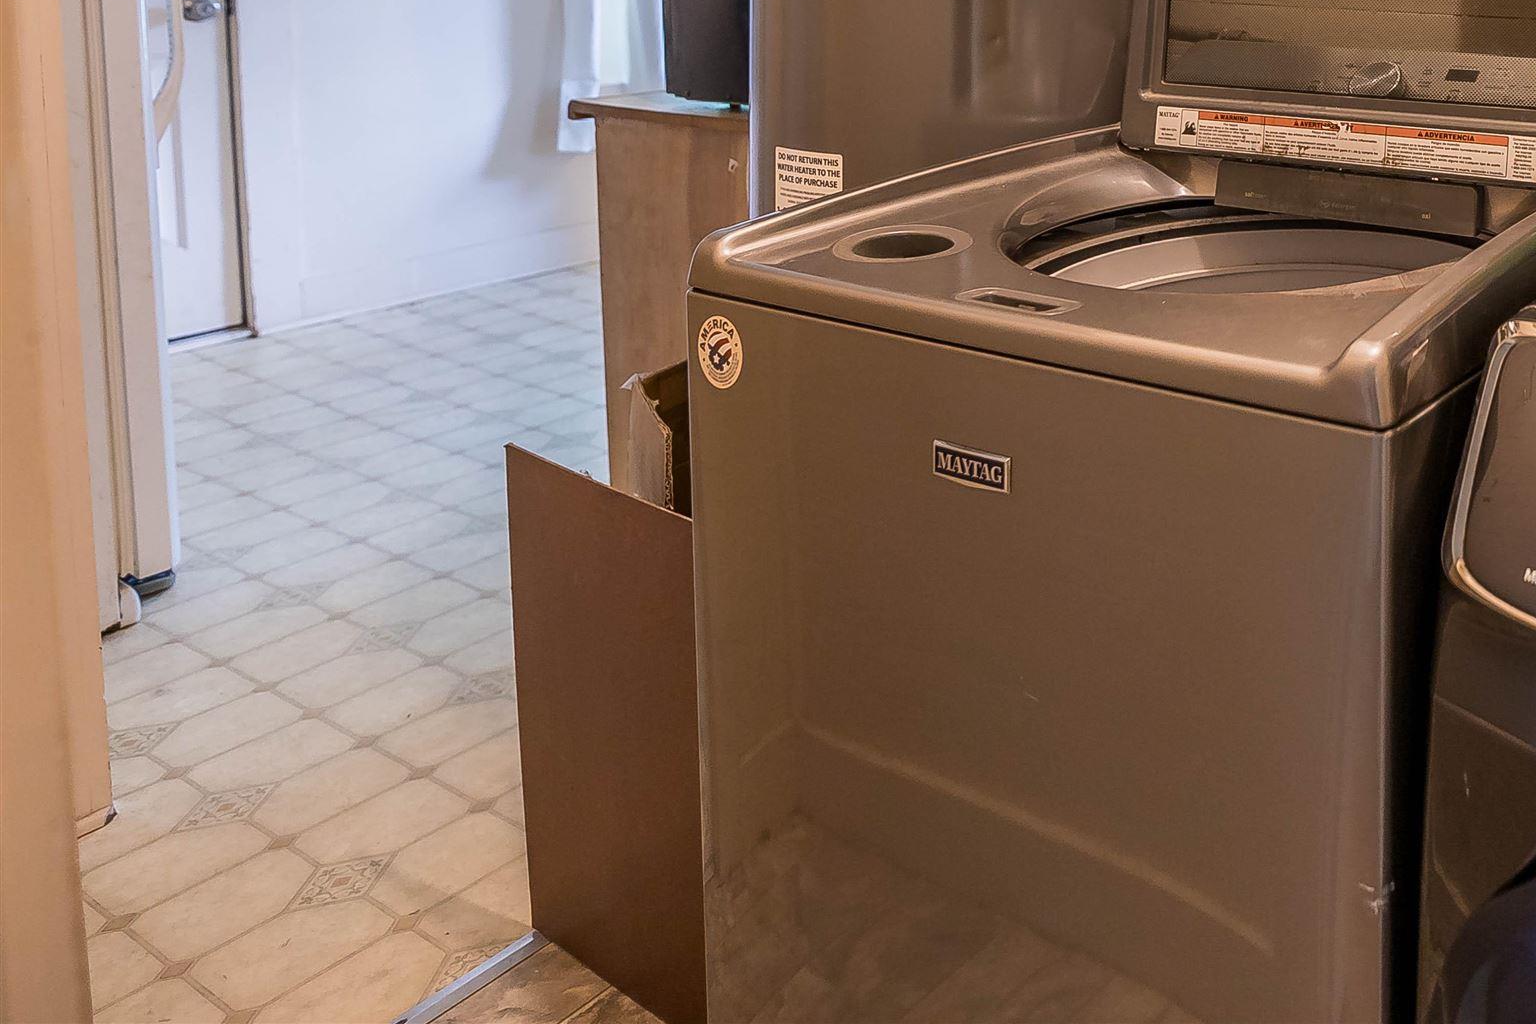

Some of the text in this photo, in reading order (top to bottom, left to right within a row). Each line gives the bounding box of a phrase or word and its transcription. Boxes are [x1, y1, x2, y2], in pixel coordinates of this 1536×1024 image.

[1220, 114, 1248, 123] WARNING
[1424, 131, 1475, 142] ADVERTENCIA
[778, 152, 839, 167] DO NOT RETURN THIS
[777, 163, 793, 172] WATER
[795, 166, 816, 176] HEATER
[827, 170, 840, 178] THE
[779, 174, 838, 189] PLACE OF PURCHASE
[700, 319, 735, 352] AMERICA
[937, 451, 1002, 483] MAYTAG
